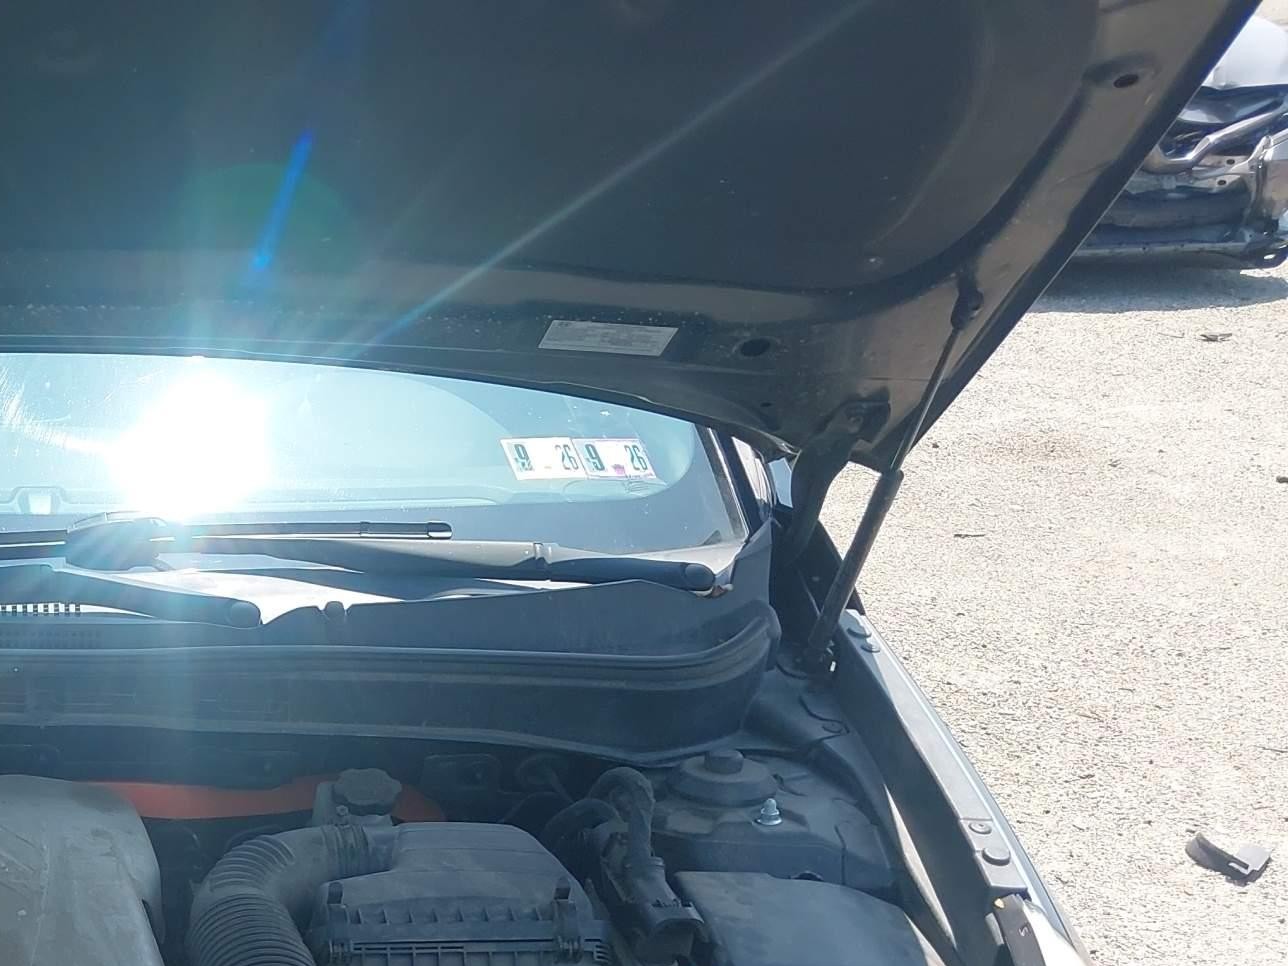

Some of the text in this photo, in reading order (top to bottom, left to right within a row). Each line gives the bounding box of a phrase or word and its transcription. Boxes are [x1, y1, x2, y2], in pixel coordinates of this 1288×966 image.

[554, 444, 579, 471] 26
[585, 443, 649, 472] 9 26
